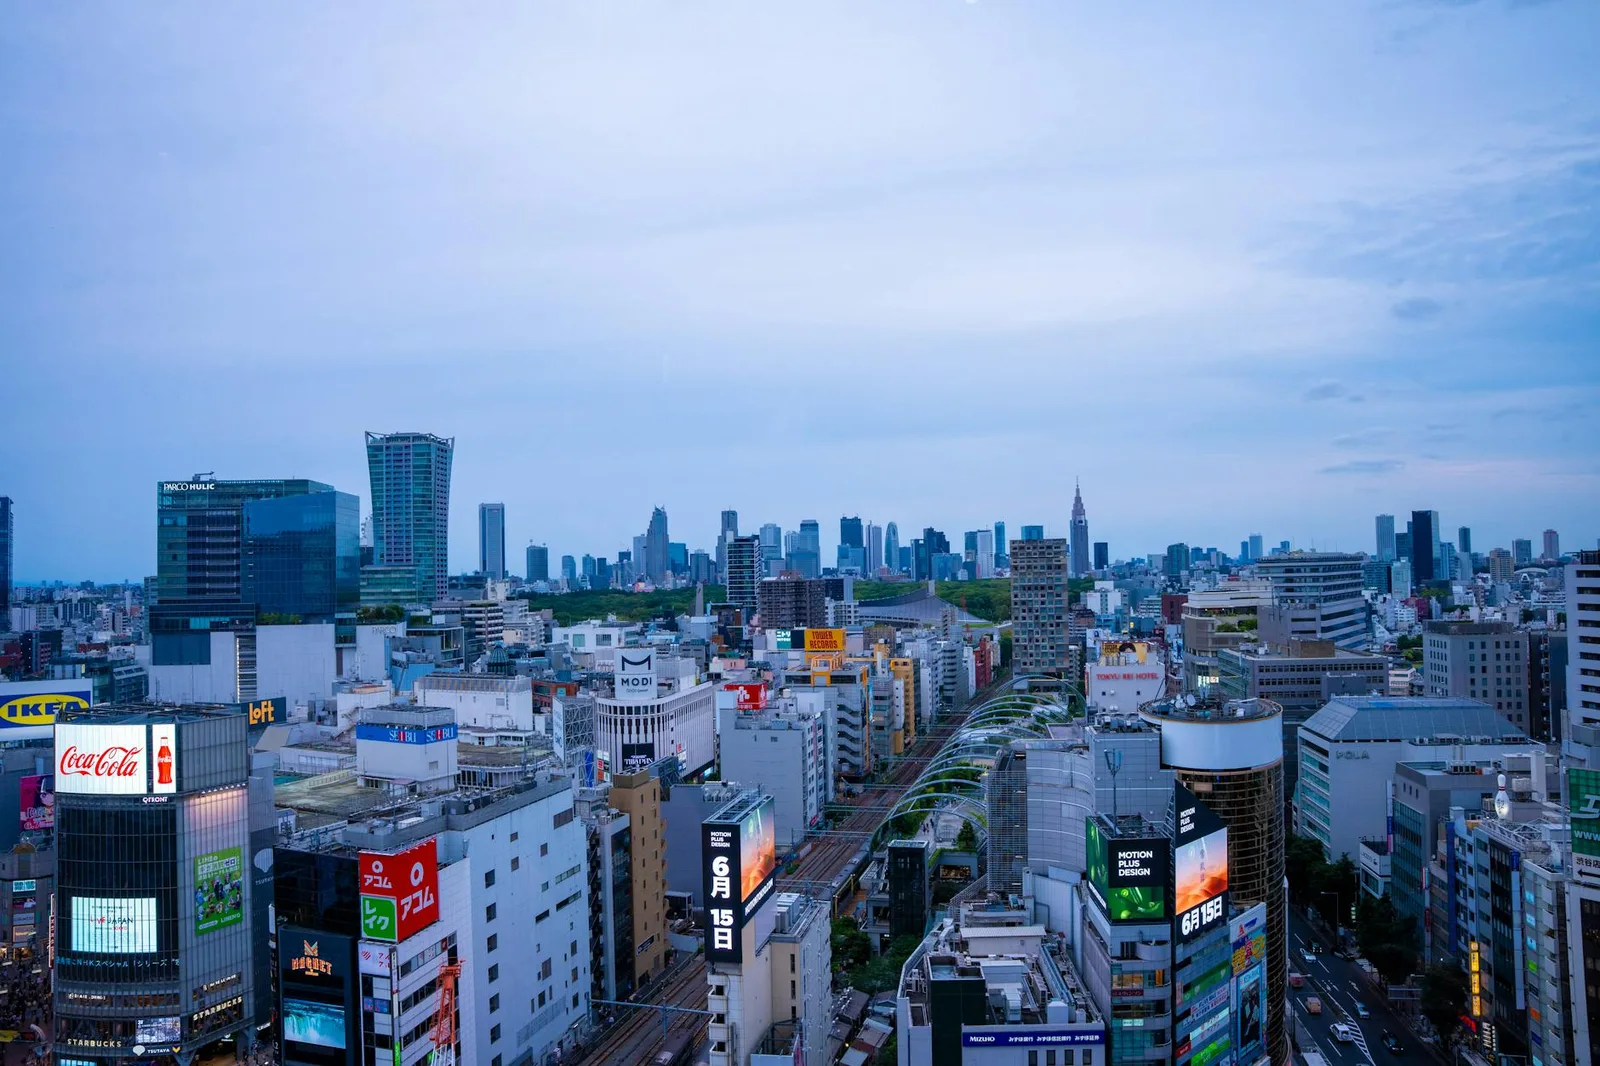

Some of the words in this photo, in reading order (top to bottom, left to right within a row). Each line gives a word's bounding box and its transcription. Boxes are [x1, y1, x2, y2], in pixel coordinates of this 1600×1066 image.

[163, 482, 189, 491] PARCO
[812, 631, 833, 639] TOWER
[809, 640, 838, 649] RECORDS
[621, 677, 652, 686] MODI
[1136, 672, 1159, 680] HOTEL
[7, 701, 83, 718] IKEA
[389, 730, 417, 743] SEIBU
[426, 727, 454, 742] SEIBU
[60, 745, 144, 777] Coca-Cola
[1335, 750, 1370, 760] POLA
[1180, 806, 1196, 818] MOTION
[1180, 816, 1191, 826] PLUS
[1180, 822, 1195, 834] DESIGN
[1118, 850, 1153, 859] MOTION
[1118, 860, 1140, 868] PLUS
[1118, 868, 1151, 877] DESIGN
[363, 874, 393, 889] アコム
[365, 900, 377, 915] レ
[400, 885, 435, 921] アコム
[107, 917, 133, 925] JAPAN
[1181, 907, 1200, 936] 6月
[1200, 895, 1222, 925] 15日
[365, 915, 390, 931] イク
[291, 956, 332, 975] MAGNET
[192, 996, 242, 1021] STARBUCKS
[67, 1038, 122, 1048] STARBUCKS
